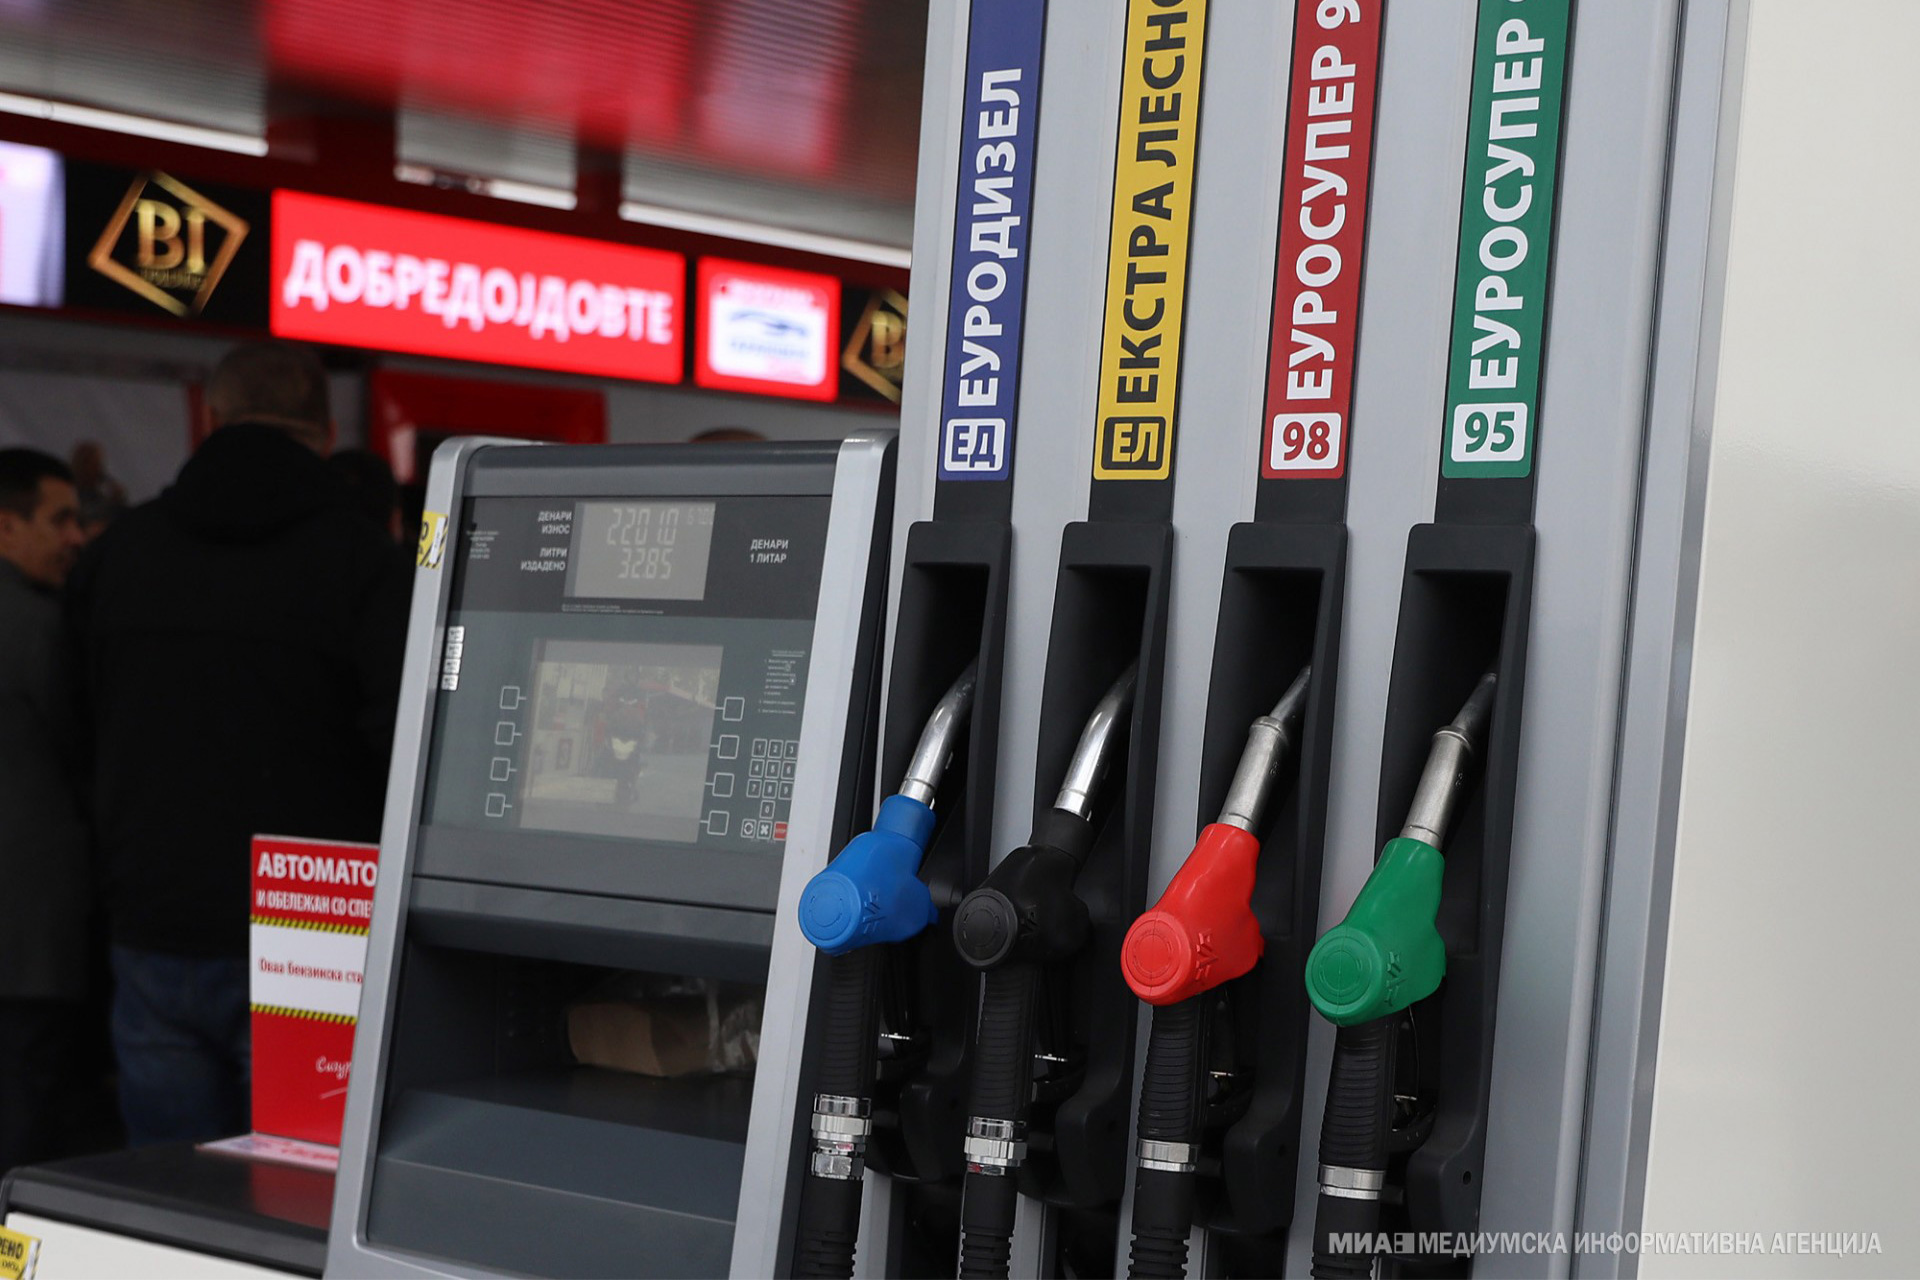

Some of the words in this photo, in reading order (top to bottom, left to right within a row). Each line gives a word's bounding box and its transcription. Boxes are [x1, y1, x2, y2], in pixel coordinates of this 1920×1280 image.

[1136, 0, 1188, 168] ЛЕСН
[1469, 18, 1545, 389] ЕУРОСУПЕР
[958, 68, 1022, 407] ЕУРОДИЗЕЛ
[1286, 45, 1356, 400] ЕУРОСУПЕР
[283, 238, 673, 344] ДОБРЕДОЈДОВТЕ
[1116, 181, 1175, 403] ЕКСТРА
[1283, 420, 1331, 461] 98
[1464, 411, 1516, 453] 95
[537, 510, 572, 522] ДЕНАРИ
[541, 524, 571, 535] ИЗНОС
[539, 547, 568, 557] ЛИТРИ
[750, 539, 789, 551] ДЕНАРИ
[756, 553, 787, 564] ЛИТАР
[520, 561, 566, 572] ИЗДАДЕНО
[257, 851, 378, 887] АВТОМАТО
[256, 890, 266, 908] И
[267, 891, 330, 914] ОБЕЛЕЖАН
[331, 896, 347, 916] СО
[0, 1237, 24, 1260] ЕНО
